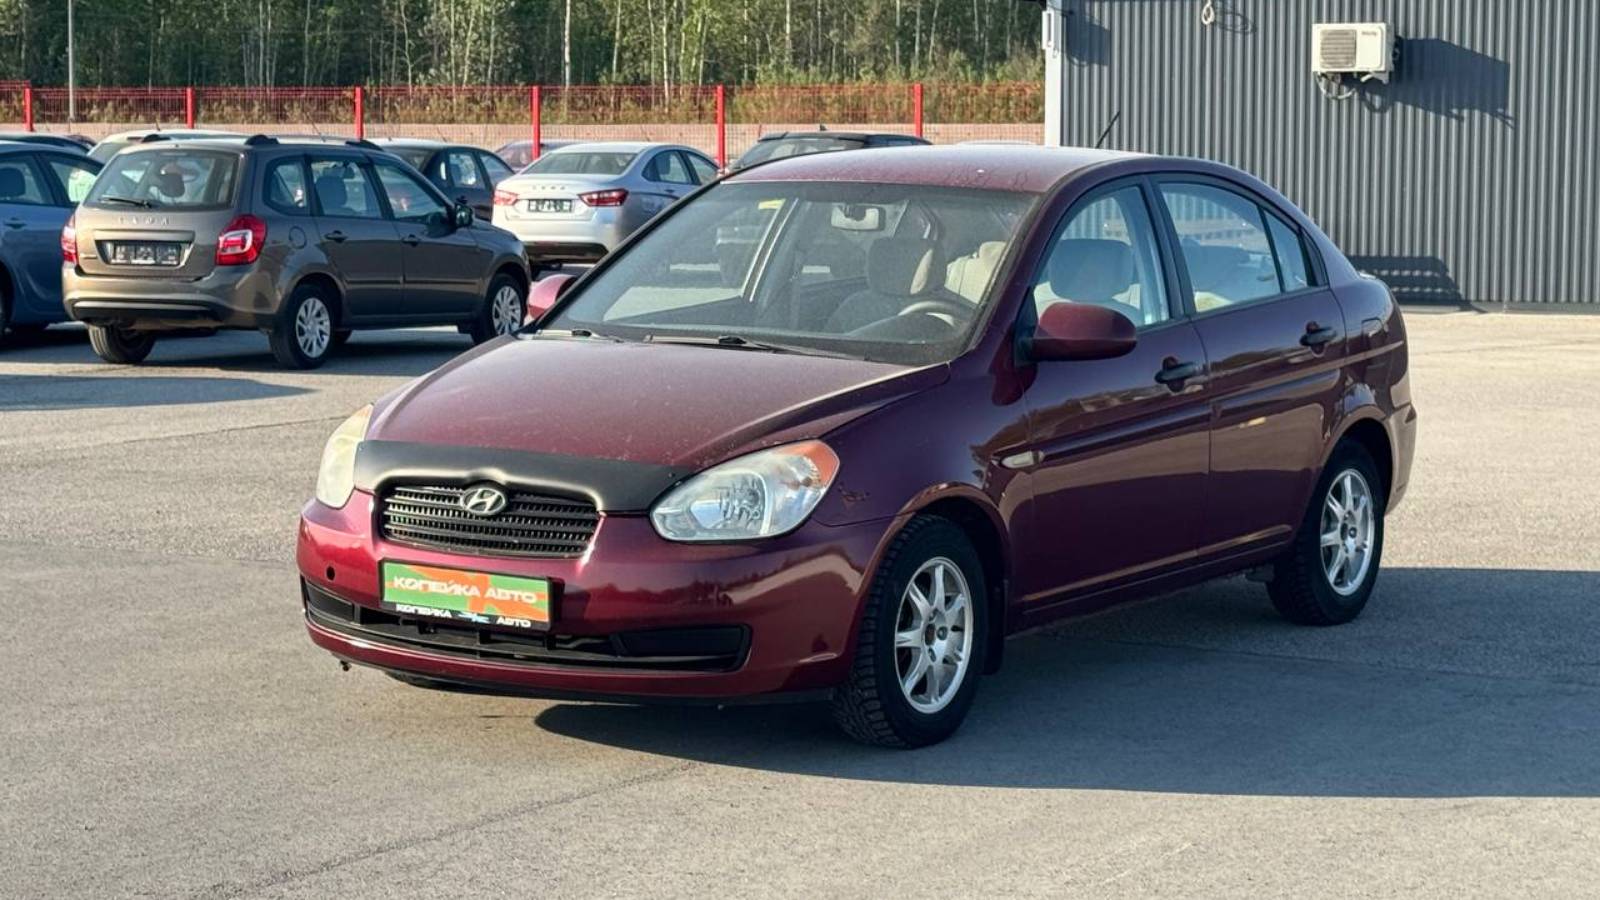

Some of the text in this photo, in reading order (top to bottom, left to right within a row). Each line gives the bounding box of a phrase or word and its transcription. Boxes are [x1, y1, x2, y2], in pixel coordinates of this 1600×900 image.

[394, 576, 538, 604] КОПЕЙКА АВТО
[496, 617, 531, 628] АВТО
